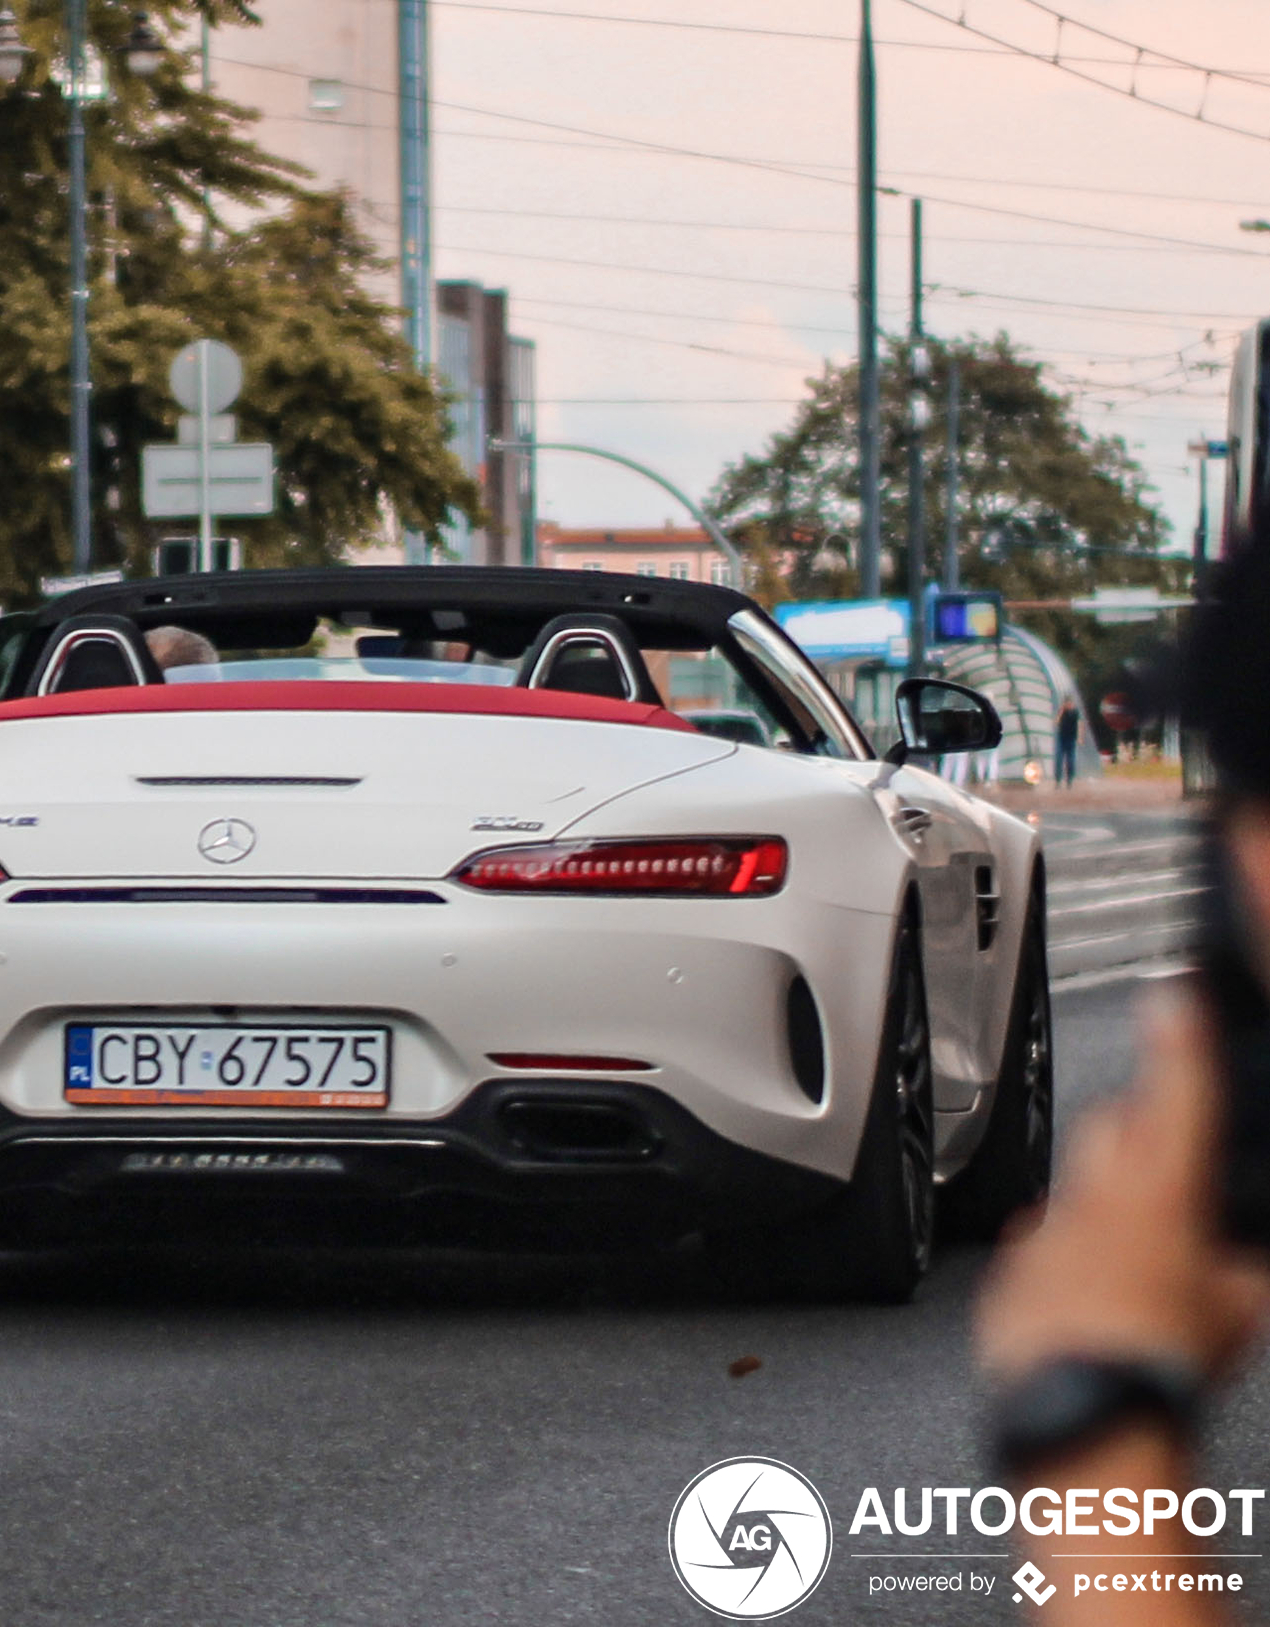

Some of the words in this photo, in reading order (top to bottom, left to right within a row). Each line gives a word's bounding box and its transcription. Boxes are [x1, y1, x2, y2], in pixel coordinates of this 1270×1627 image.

[70, 1066, 90, 1081] PL
[98, 1033, 197, 1087] CBY
[217, 1035, 378, 1088] 67575
